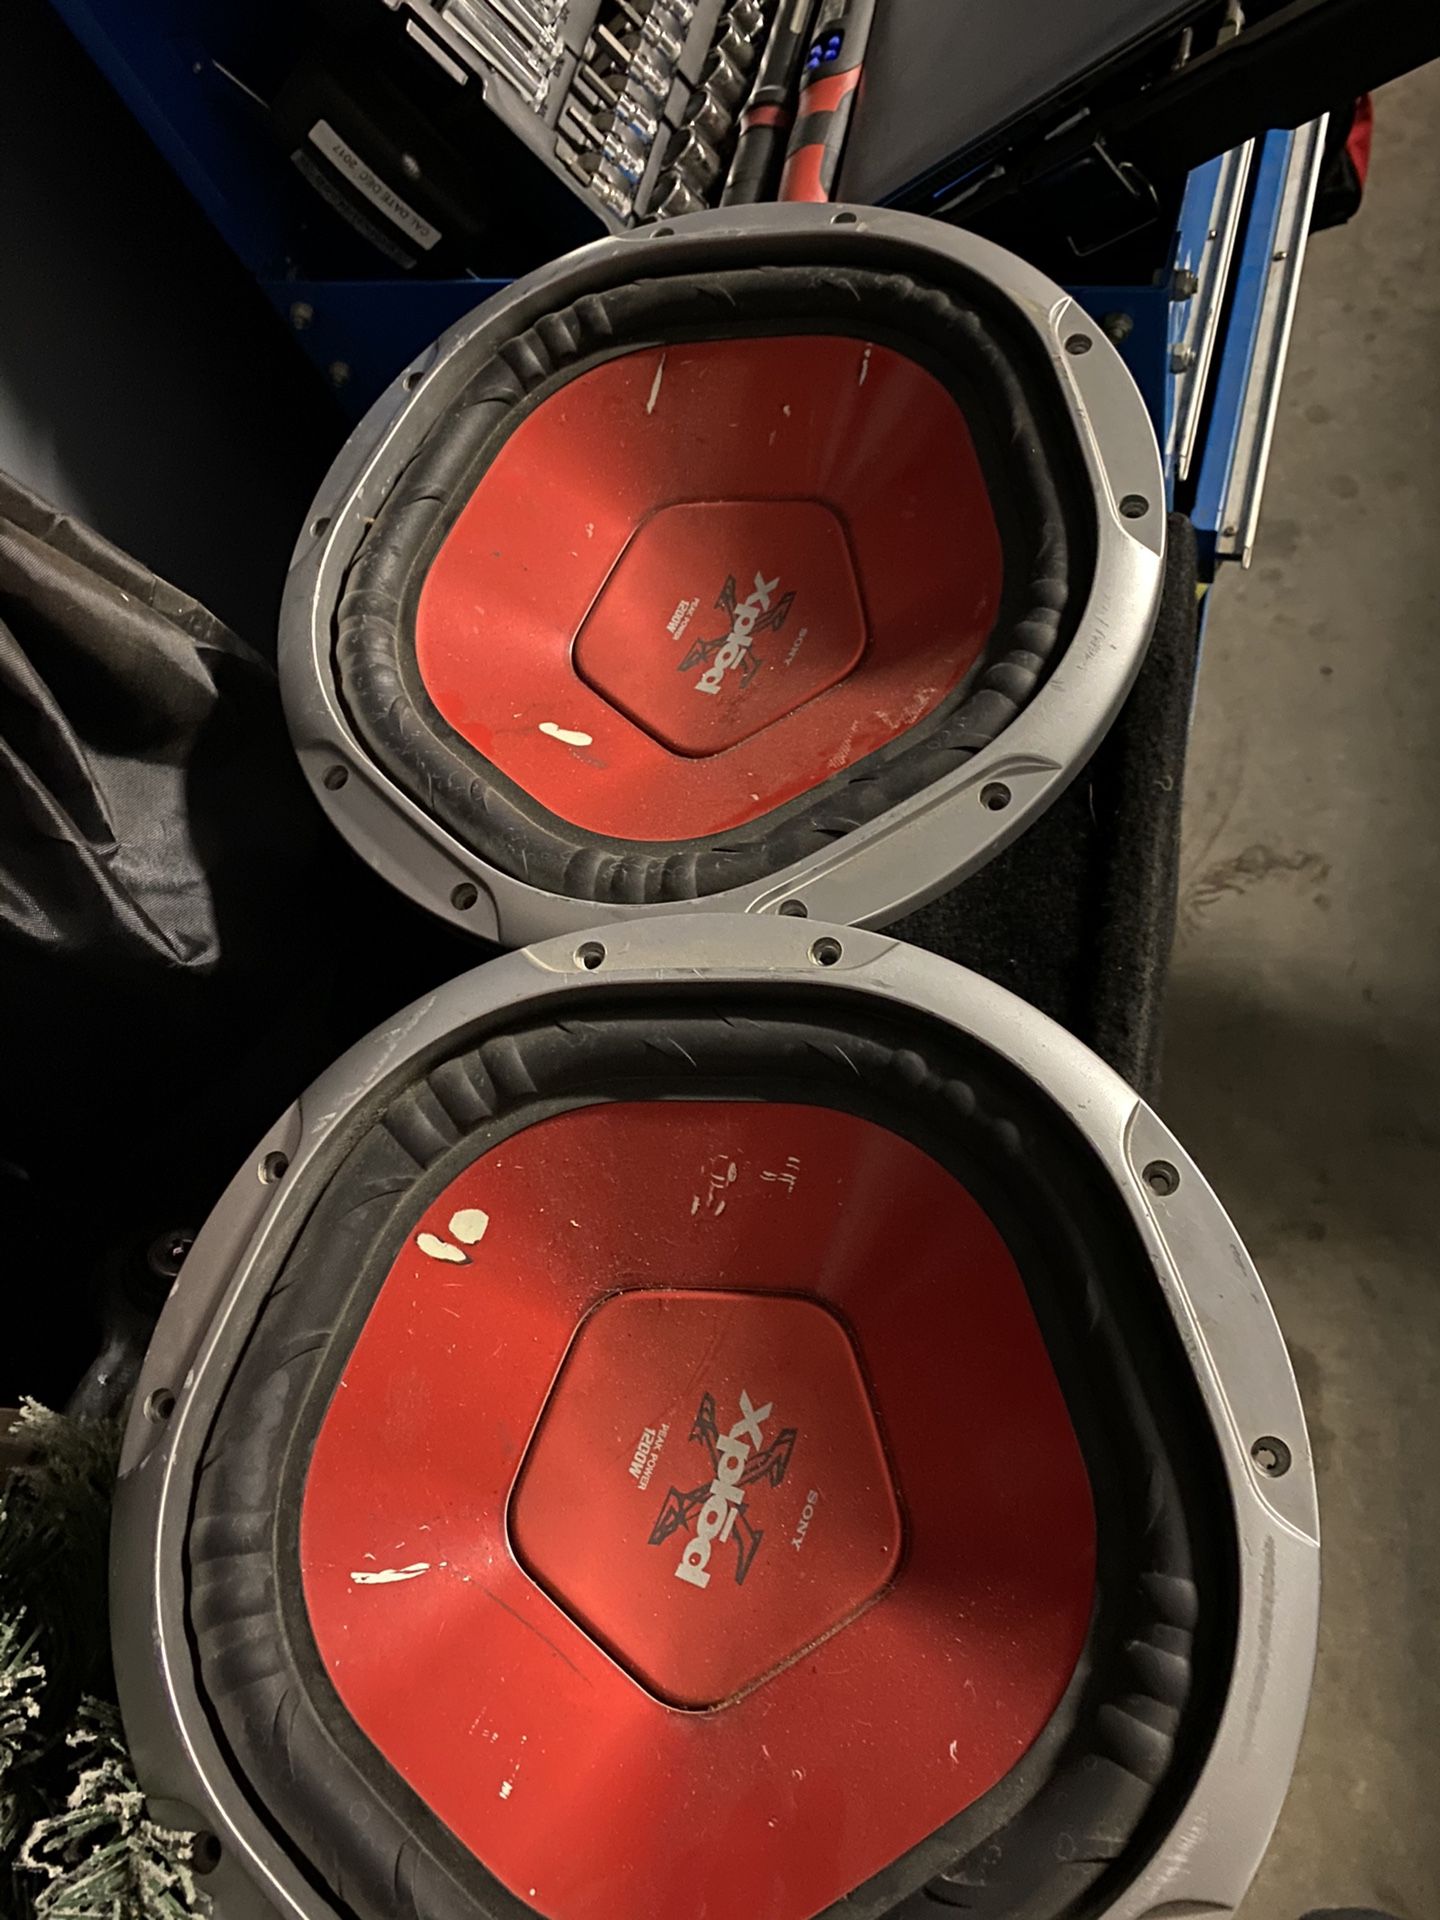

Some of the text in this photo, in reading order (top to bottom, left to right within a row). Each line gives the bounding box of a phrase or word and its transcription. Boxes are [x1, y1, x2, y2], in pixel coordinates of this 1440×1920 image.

[332, 145, 357, 169] 2017
[359, 171, 382, 195] DEC
[380, 191, 409, 220] DATE
[666, 599, 690, 633] 1200W
[628, 1426, 656, 1479] 1200W
[637, 1423, 670, 1491] PEAK POWER
[791, 1489, 819, 1552] SONY
